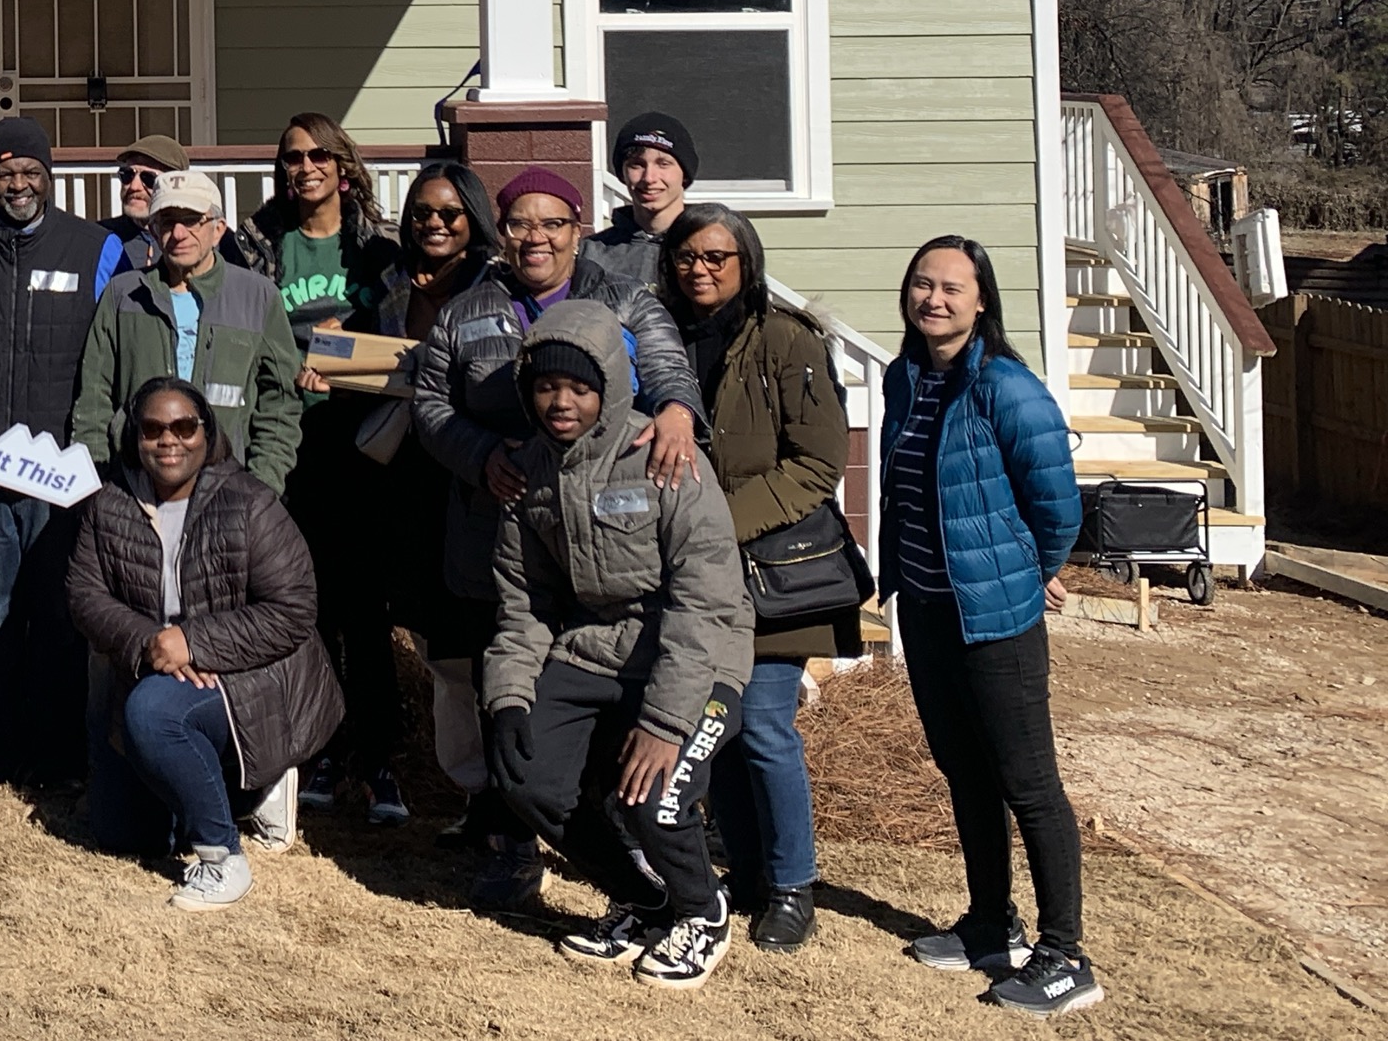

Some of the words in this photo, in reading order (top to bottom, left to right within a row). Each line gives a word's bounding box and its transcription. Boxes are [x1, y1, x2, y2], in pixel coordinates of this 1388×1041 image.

[169, 175, 185, 190] T
[17, 457, 77, 493] This!
[1043, 975, 1076, 999] HOKA
